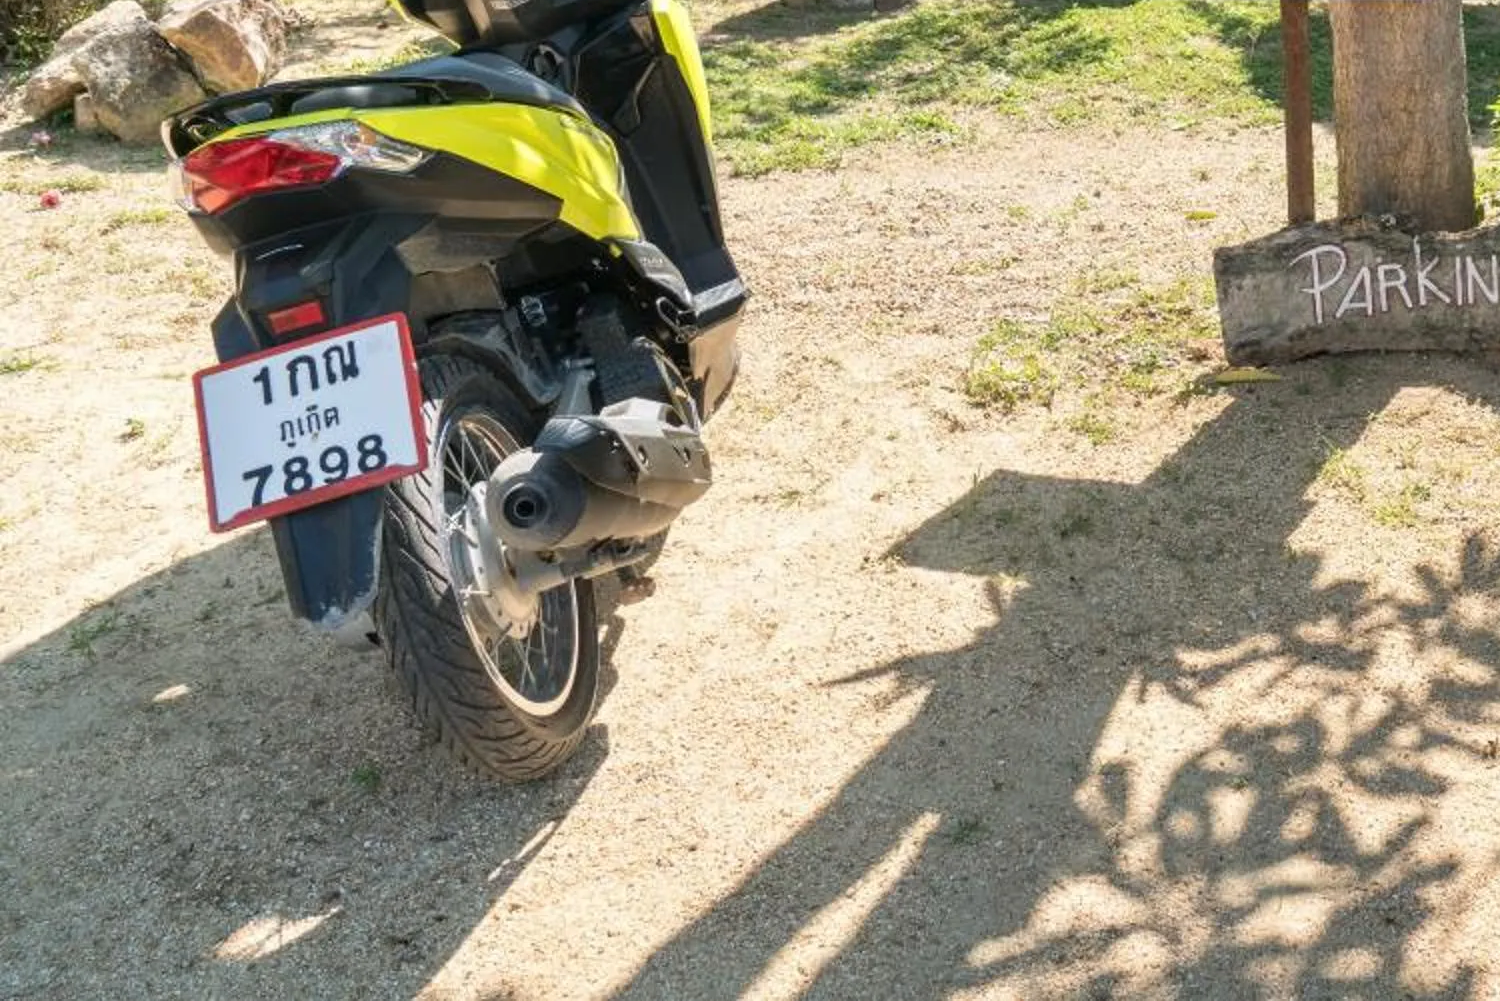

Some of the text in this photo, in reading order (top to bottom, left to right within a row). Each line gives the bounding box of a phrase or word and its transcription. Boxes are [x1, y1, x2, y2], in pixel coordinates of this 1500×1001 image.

[279, 404, 341, 448] ภูเก็ต
[242, 433, 388, 508] 7898
